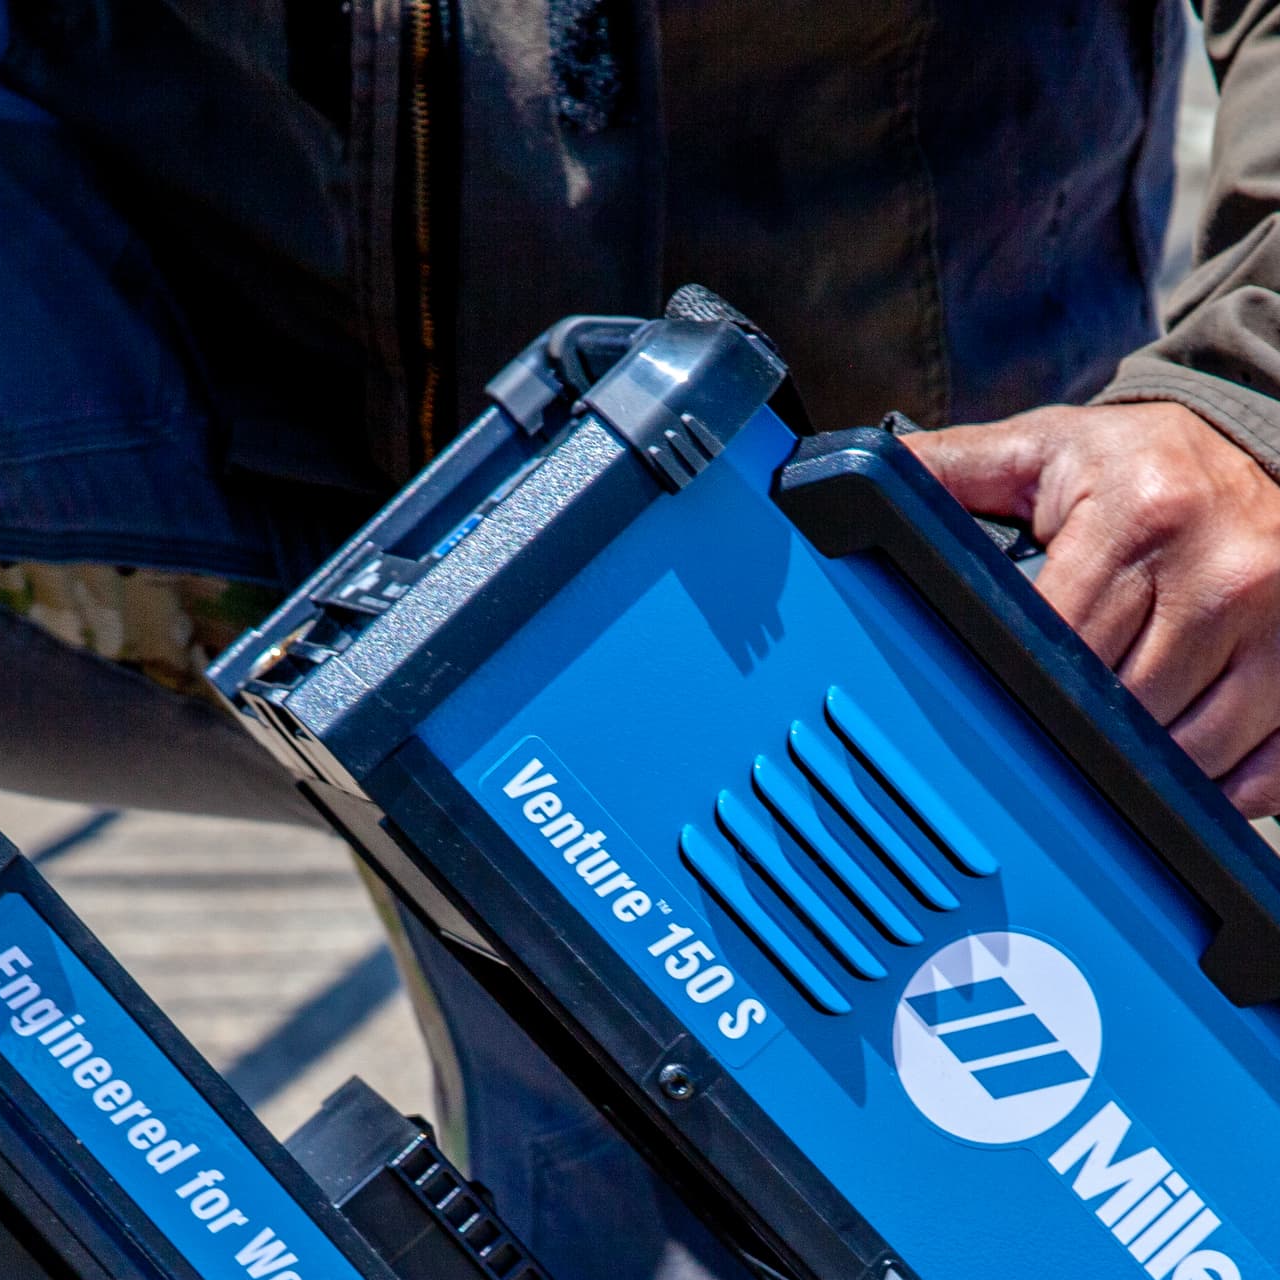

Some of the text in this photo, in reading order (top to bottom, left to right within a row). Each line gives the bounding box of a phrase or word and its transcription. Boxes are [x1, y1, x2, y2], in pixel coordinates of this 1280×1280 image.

[647, 922, 735, 1005] 150
[717, 997, 766, 1039] S
[174, 1169, 250, 1234] for
